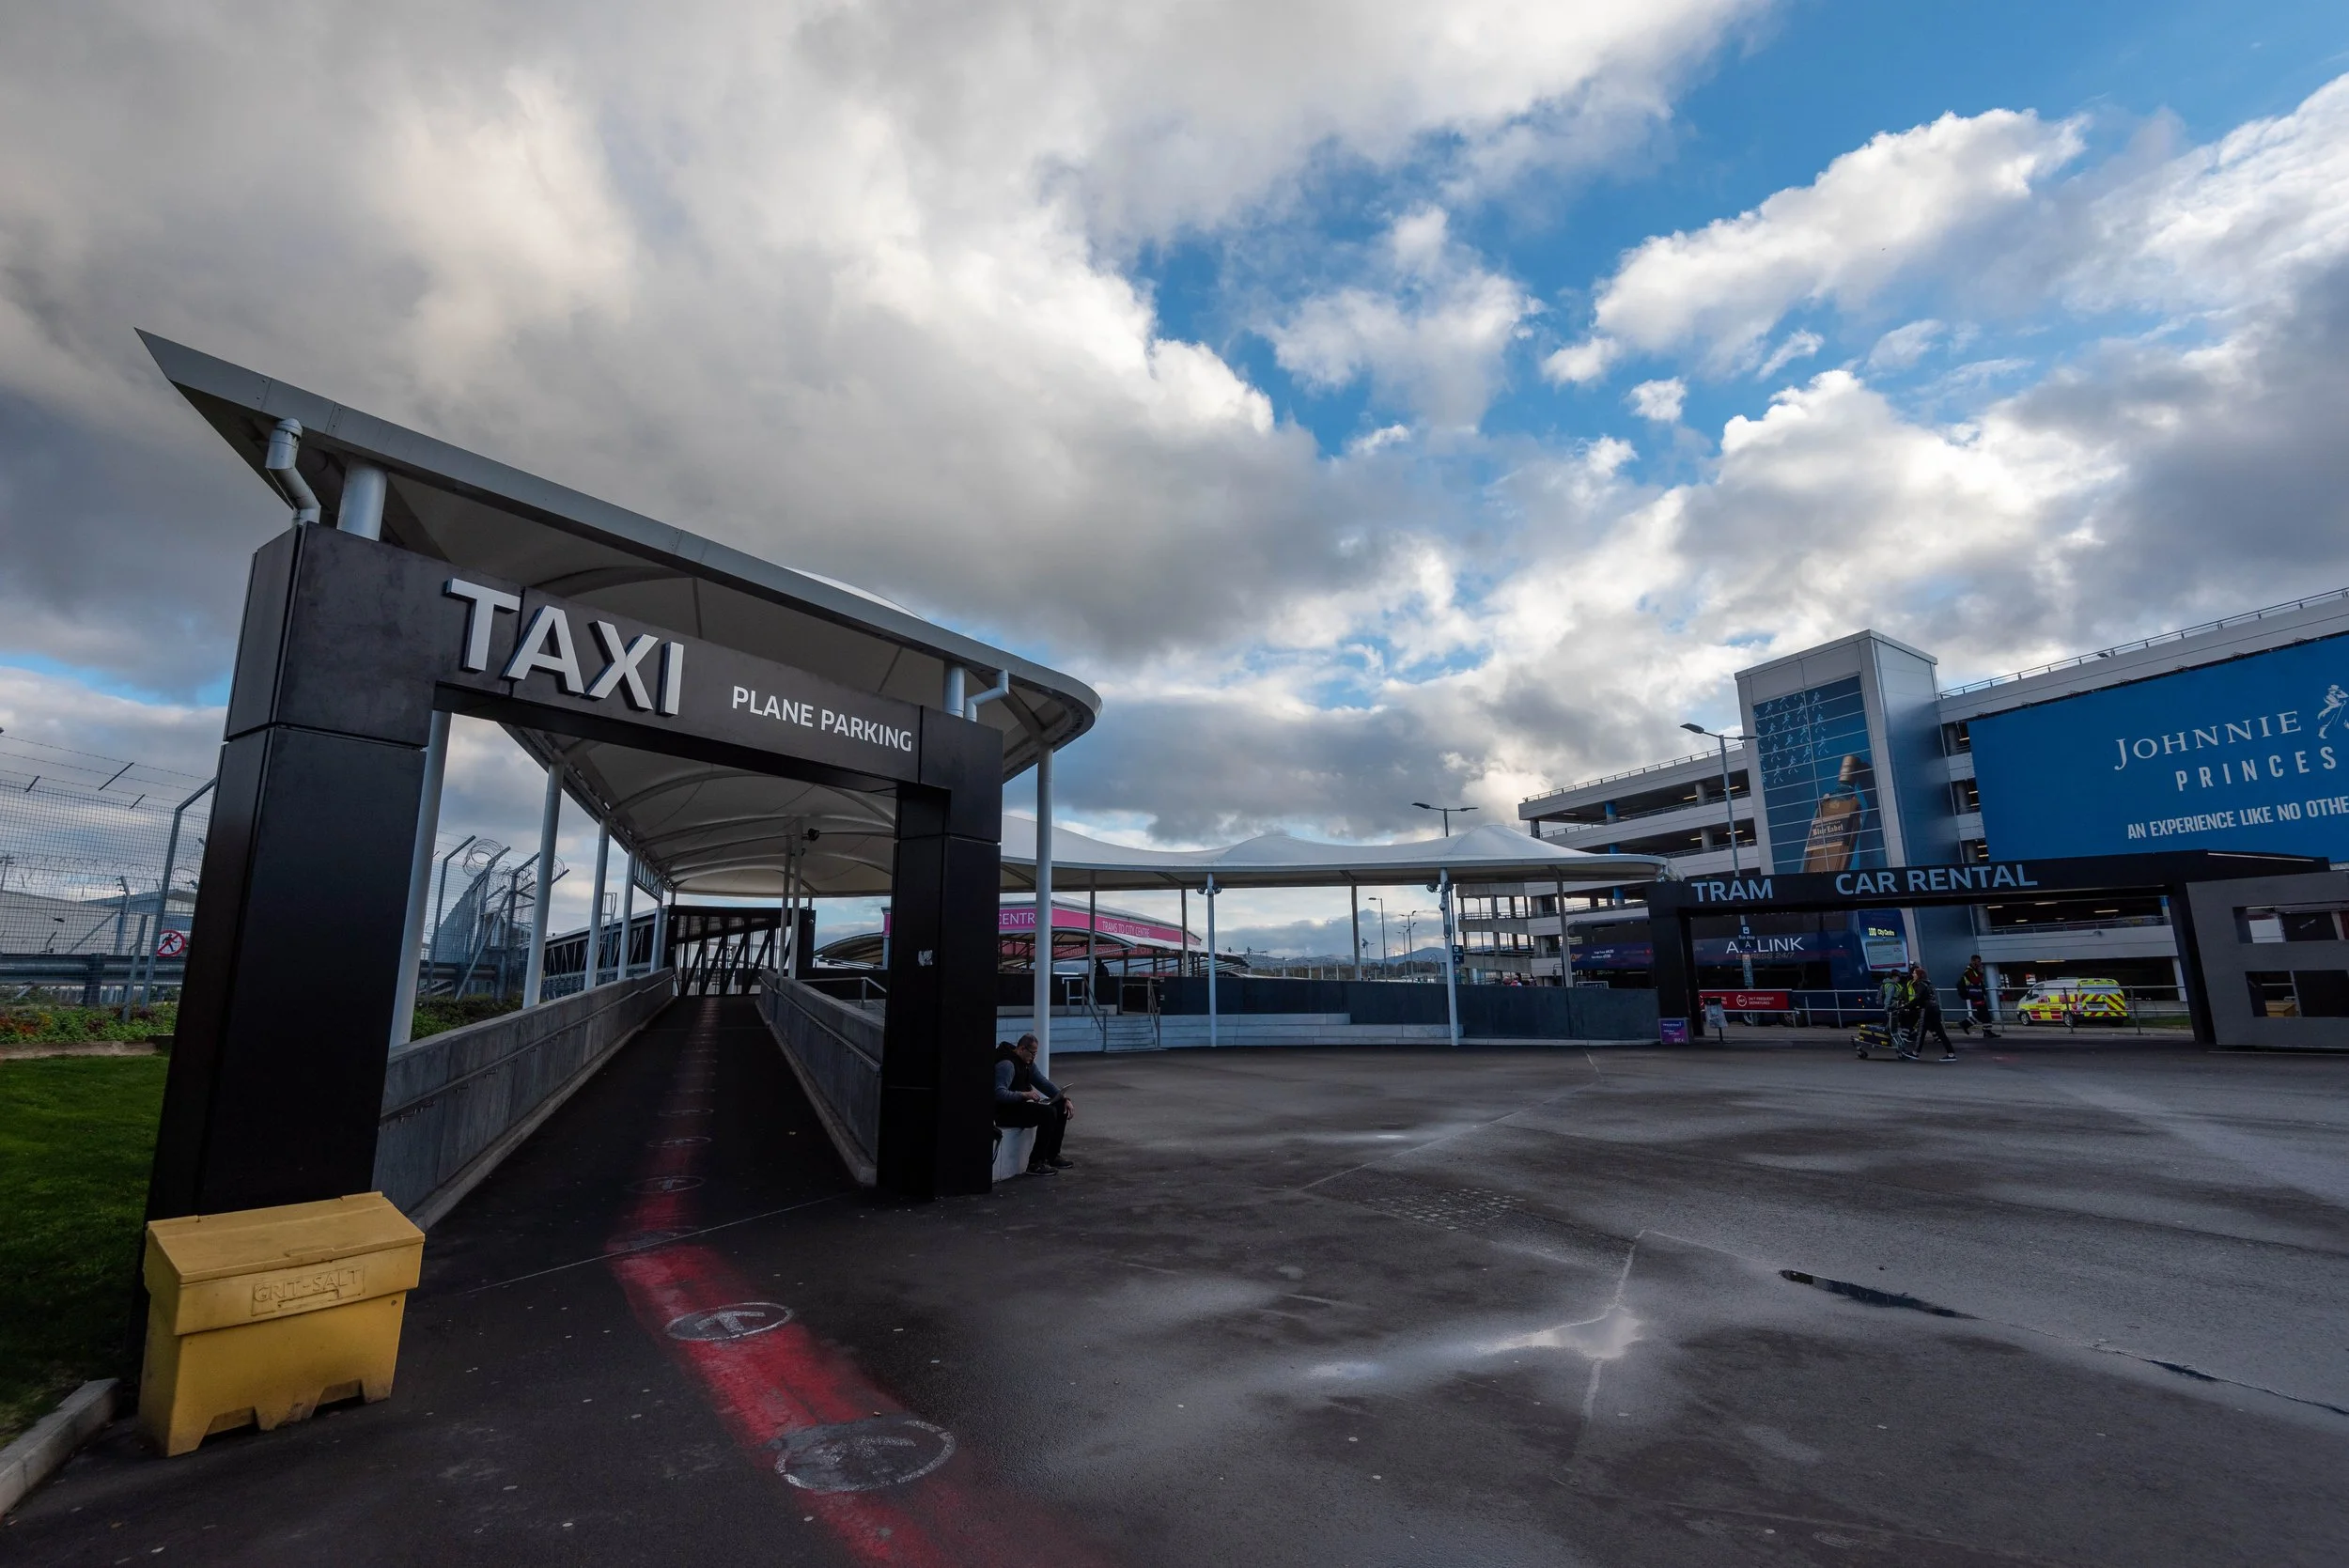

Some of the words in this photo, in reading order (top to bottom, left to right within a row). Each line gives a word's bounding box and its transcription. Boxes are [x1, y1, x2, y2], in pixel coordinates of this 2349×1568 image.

[443, 578, 685, 717] TAXI
[732, 685, 814, 728] PLANE
[820, 707, 912, 753] PARKING
[2114, 710, 2302, 770] JOHNNIE
[2176, 746, 2337, 792] PRINCES
[2127, 822, 2146, 840] AN
[2150, 812, 2236, 837] EXPERIENCE
[2240, 806, 2273, 825] LIKE
[2277, 802, 2301, 821] NO
[1691, 878, 1774, 902] TRAM
[1835, 871, 1899, 895] CAR
[1908, 863, 2038, 892] RENTAL
[999, 912, 1035, 925] ENTR
[1102, 921, 1118, 933] TRAMS
[1118, 924, 1125, 934] TO
[1125, 925, 1135, 936] CITY
[1135, 927, 1150, 938] CENTRE
[1726, 937, 1805, 955] ALINK
[254, 1270, 362, 1303] GRIT-SALT
